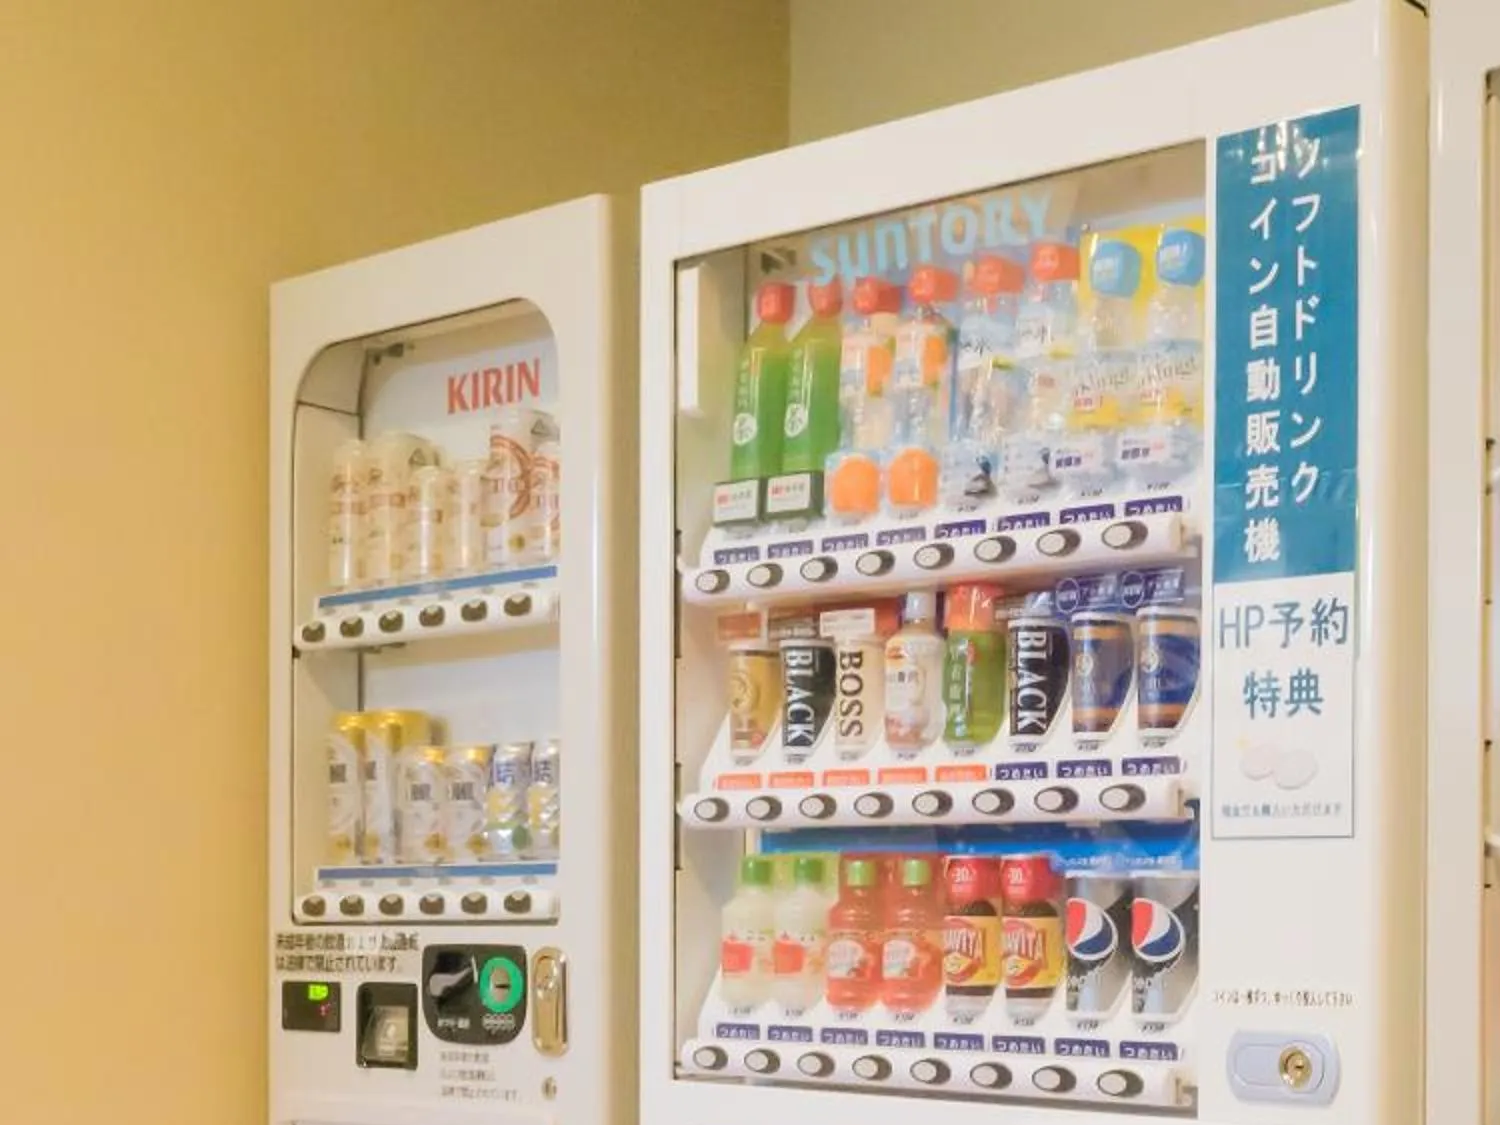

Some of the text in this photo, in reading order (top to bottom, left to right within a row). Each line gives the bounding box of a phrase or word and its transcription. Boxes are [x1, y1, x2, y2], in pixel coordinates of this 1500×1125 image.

[809, 191, 1053, 284] SUNTORY
[1244, 152, 1281, 562] コイン自動販売機
[1291, 134, 1321, 503] ソフトドリンク
[446, 358, 540, 415] KIRIN
[1218, 599, 1349, 651] HP予約
[786, 649, 815, 744] BLACK
[839, 651, 864, 738] BOSS
[1017, 630, 1048, 730] BLACK
[1242, 667, 1324, 719] 特典
